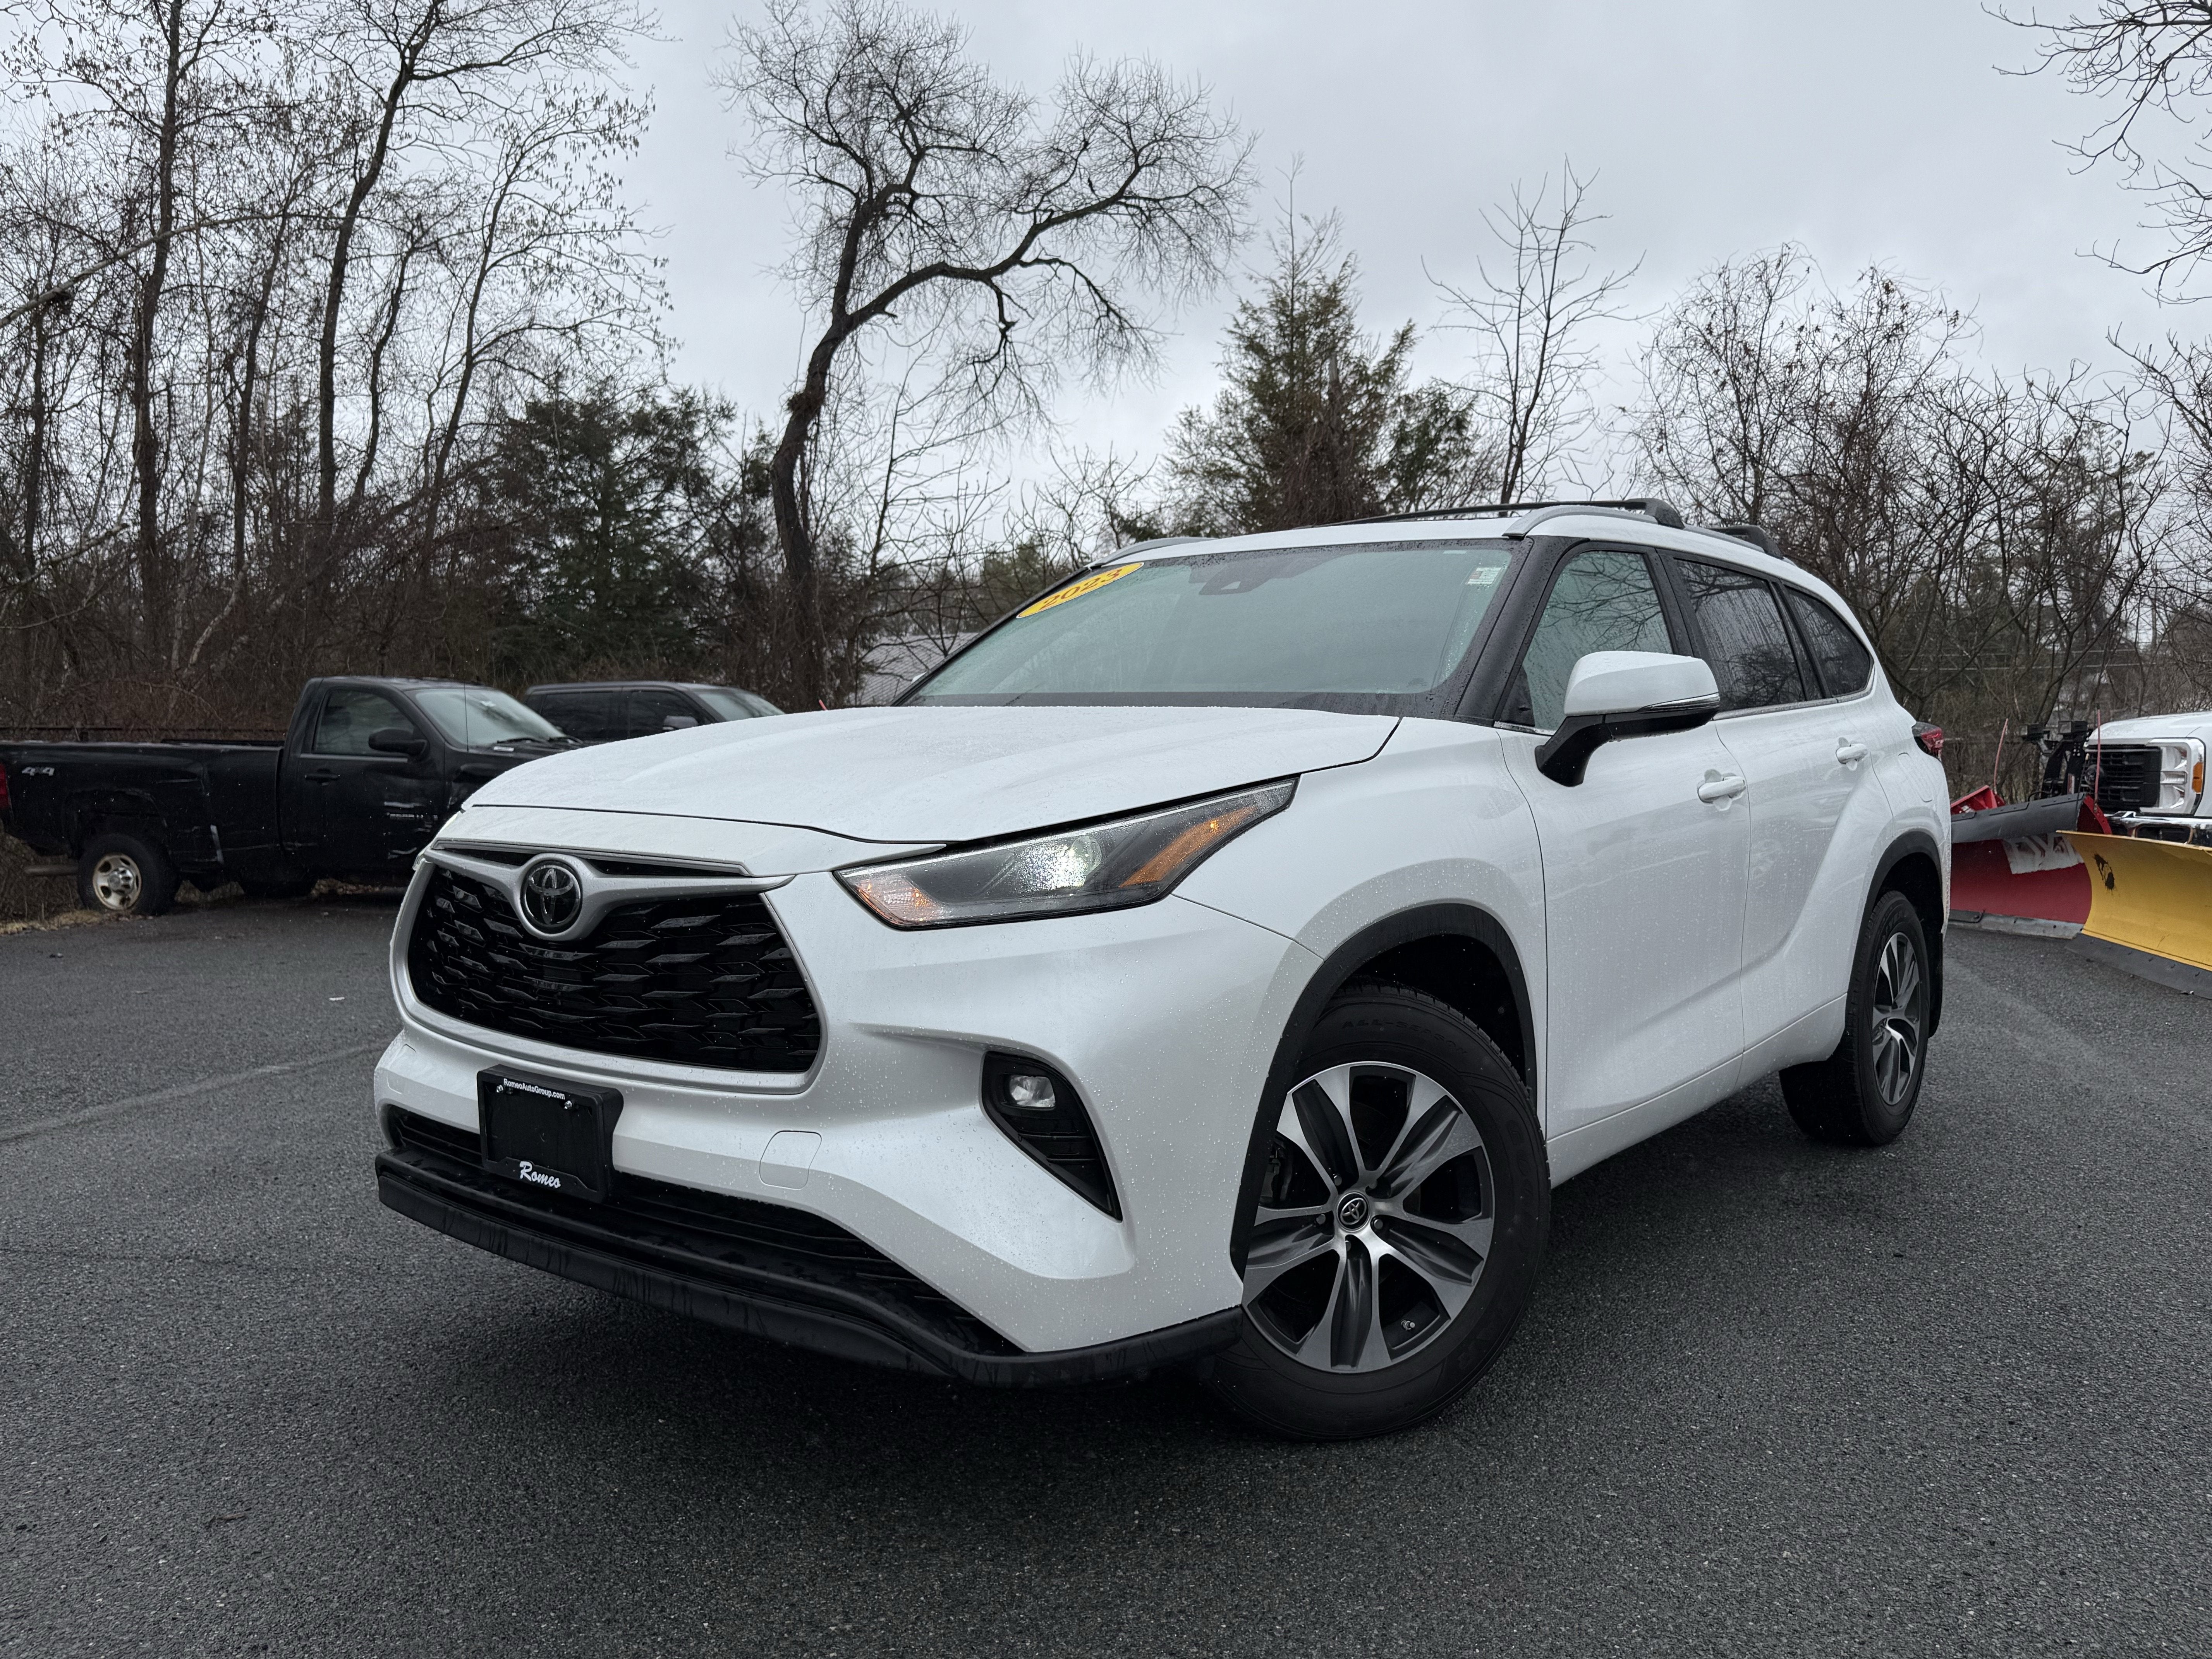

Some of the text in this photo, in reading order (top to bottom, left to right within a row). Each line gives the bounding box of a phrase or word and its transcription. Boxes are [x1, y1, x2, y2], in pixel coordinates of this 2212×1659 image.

[1039, 568, 1122, 610] 2023
[503, 1078, 565, 1100] RomeoAutoGroup.com
[520, 1161, 561, 1188] Romeo
